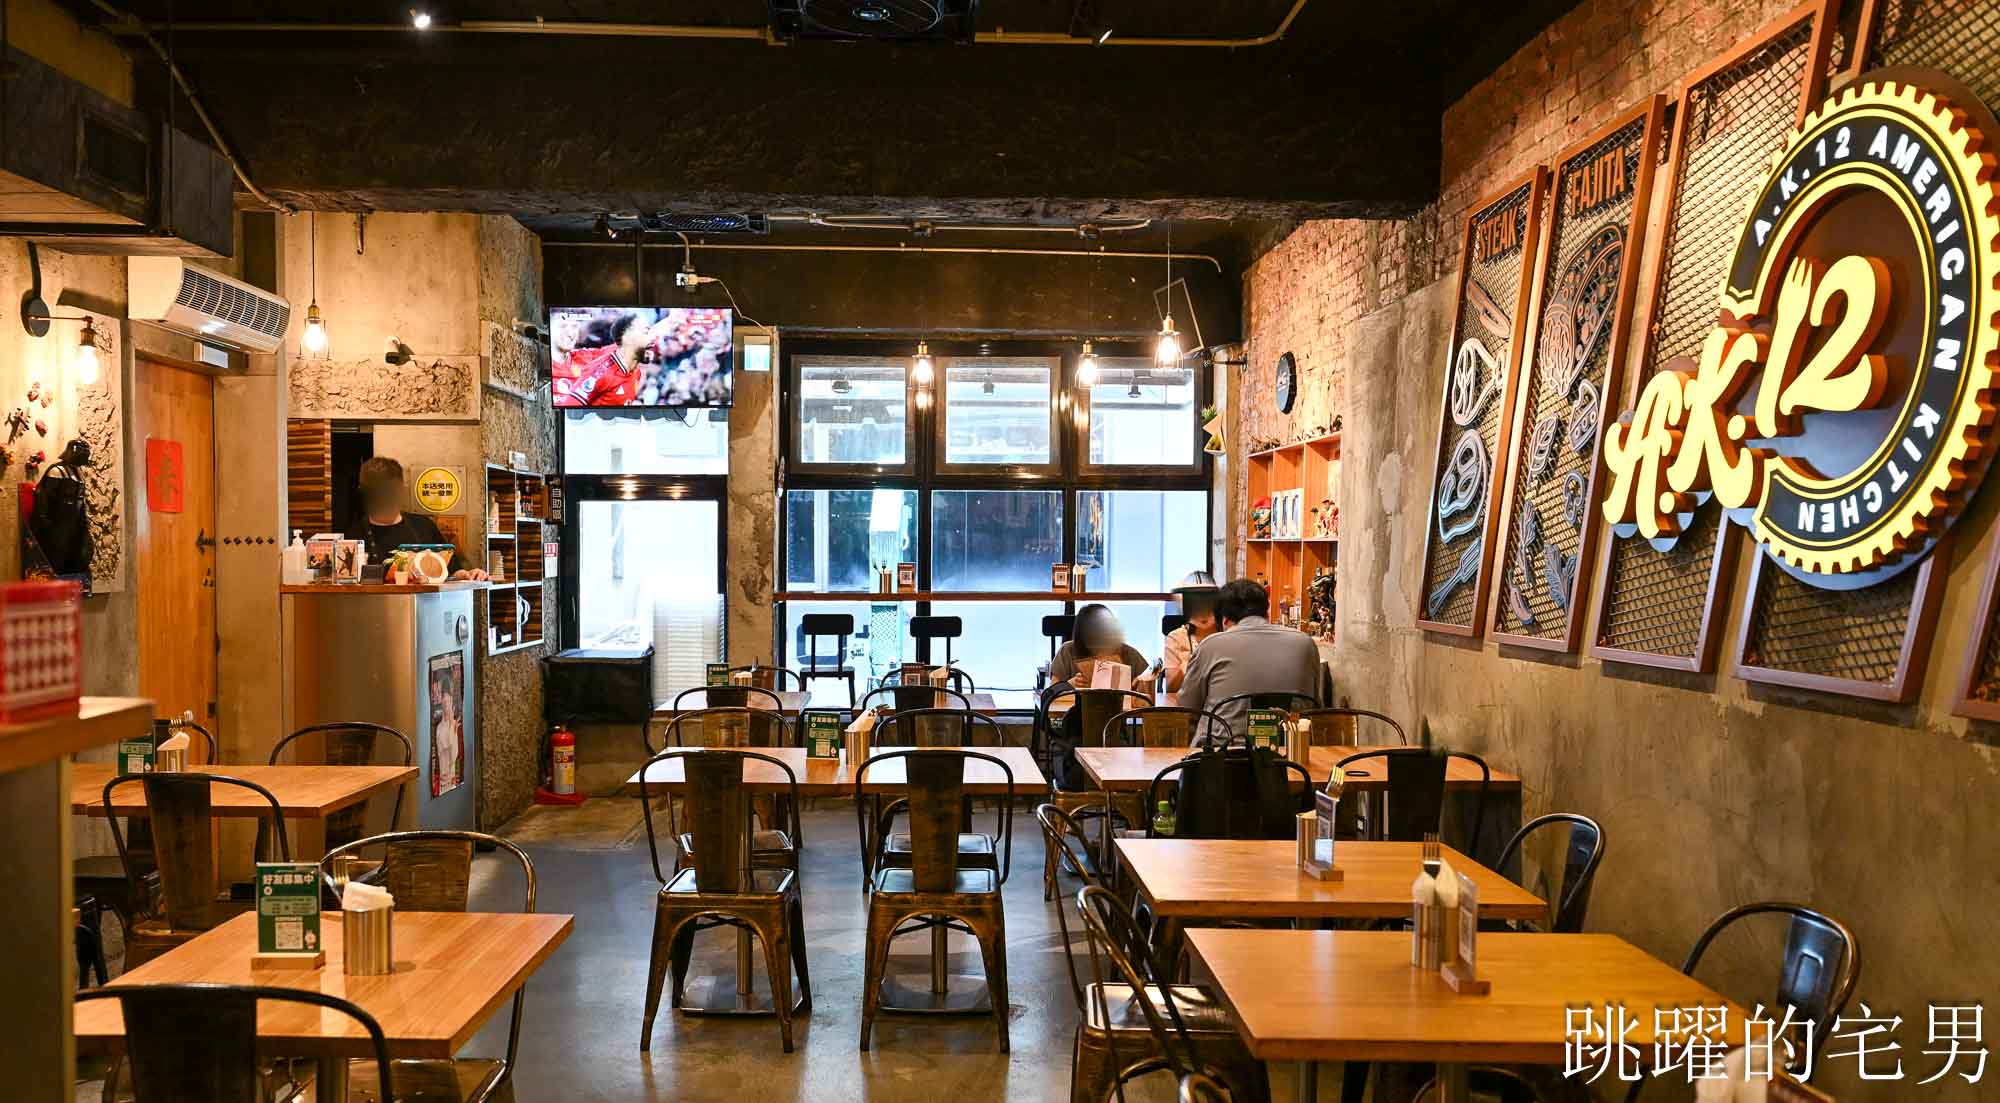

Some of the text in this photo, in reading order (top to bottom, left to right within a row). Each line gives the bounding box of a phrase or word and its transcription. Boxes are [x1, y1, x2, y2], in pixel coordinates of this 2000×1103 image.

[1570, 145, 1625, 216] FAJITA
[1478, 204, 1519, 264] STEAK
[1868, 125, 1965, 372] AMERICAN
[1797, 402, 1941, 533] KITCHEN
[552, 487, 562, 520] 自助區
[262, 874, 315, 885] 好友募集中
